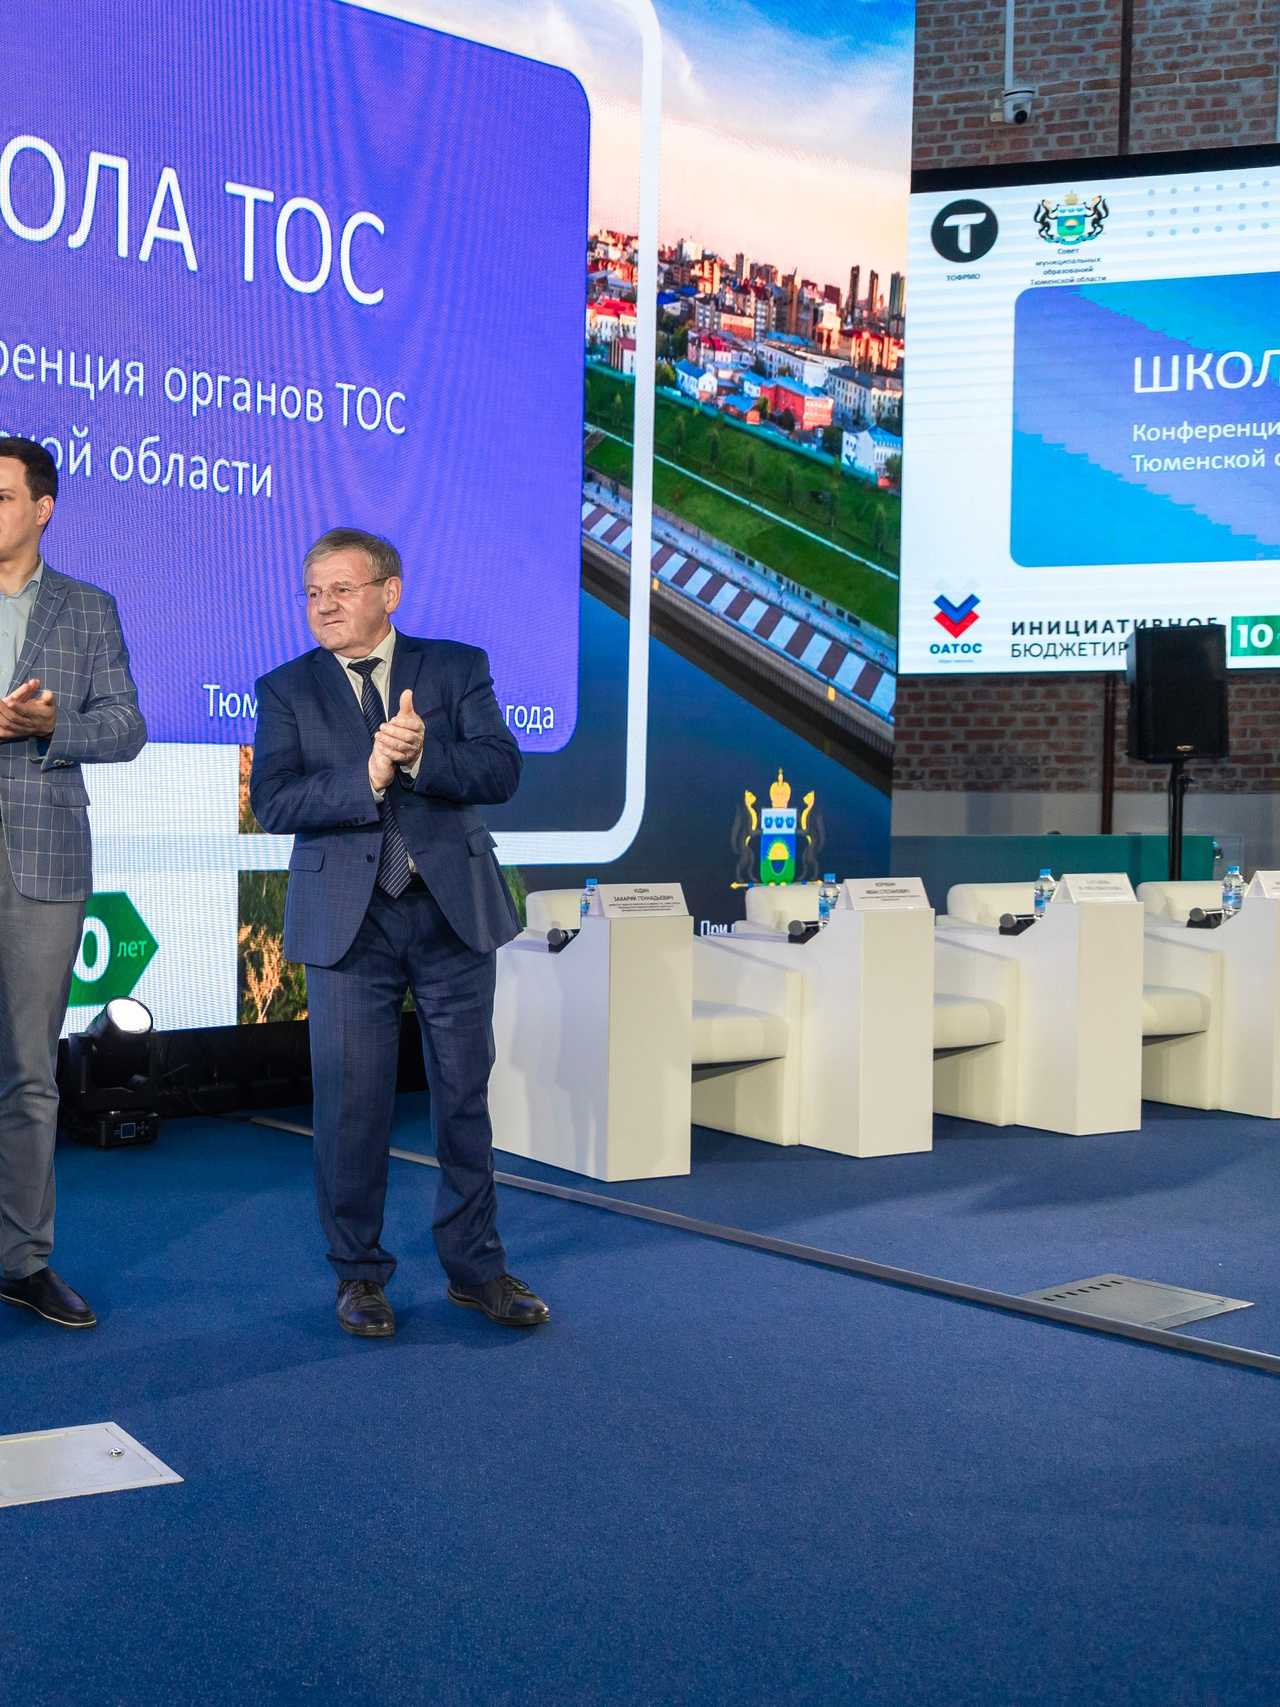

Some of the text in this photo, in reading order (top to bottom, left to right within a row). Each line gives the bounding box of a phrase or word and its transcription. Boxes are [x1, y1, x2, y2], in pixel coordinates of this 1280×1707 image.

[224, 181, 386, 305] ТОС
[1057, 247, 1079, 255] Совет
[1035, 256, 1101, 267] муниципальных
[1043, 266, 1094, 276] образований
[1031, 275, 1107, 286] Тюменской области
[164, 366, 323, 423] органов
[334, 382, 406, 435] ТОС
[110, 434, 273, 498] области
[1131, 448, 1266, 473] Тюменской
[1237, 623, 1273, 649] 10
[930, 643, 983, 654] ОАТОС
[506, 705, 554, 734] года
[117, 941, 147, 958] лет
